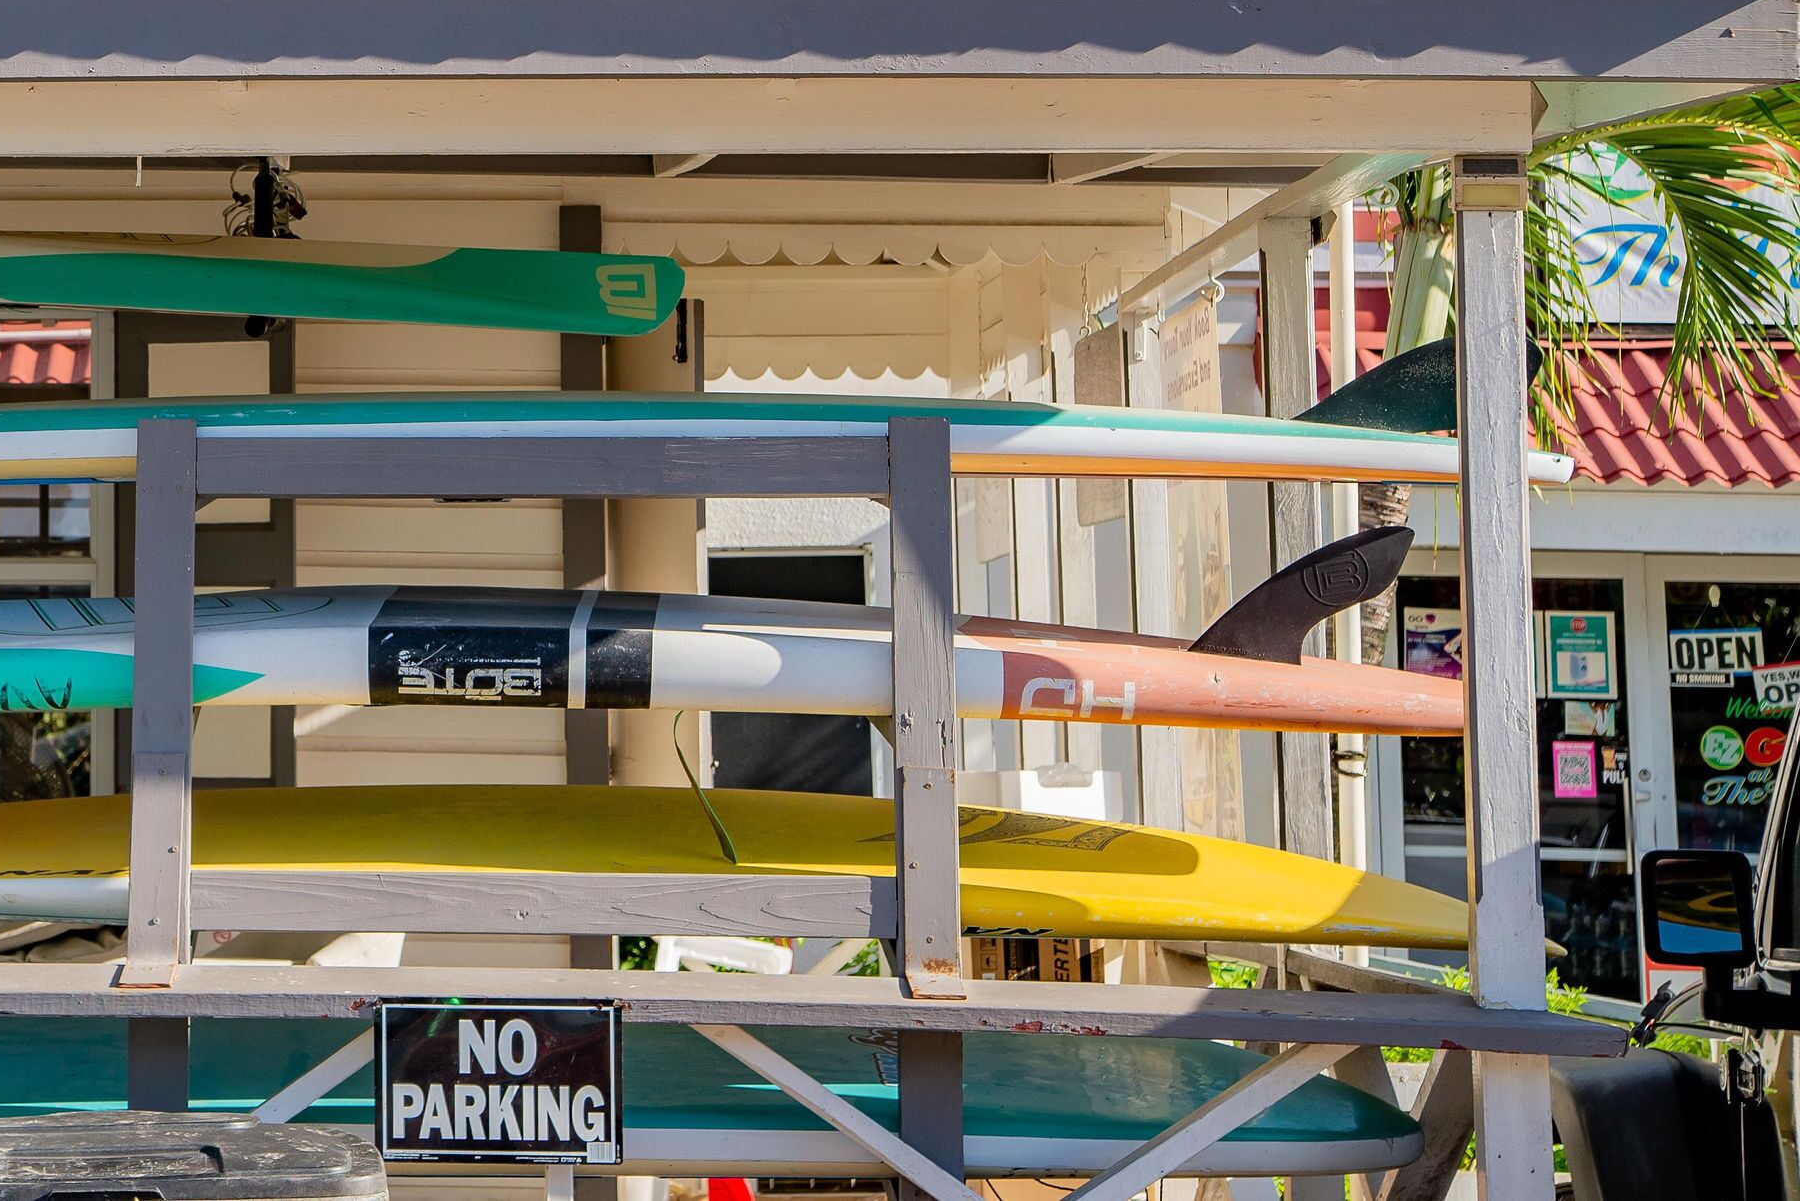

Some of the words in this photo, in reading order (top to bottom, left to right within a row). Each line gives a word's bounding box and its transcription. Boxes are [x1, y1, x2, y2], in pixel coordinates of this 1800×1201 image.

[1675, 636, 1758, 670] OPEN
[1688, 673, 1726, 684] SMOKING
[1701, 774, 1766, 806] The
[458, 1019, 538, 1076] NO
[392, 1083, 605, 1142] PARKING
